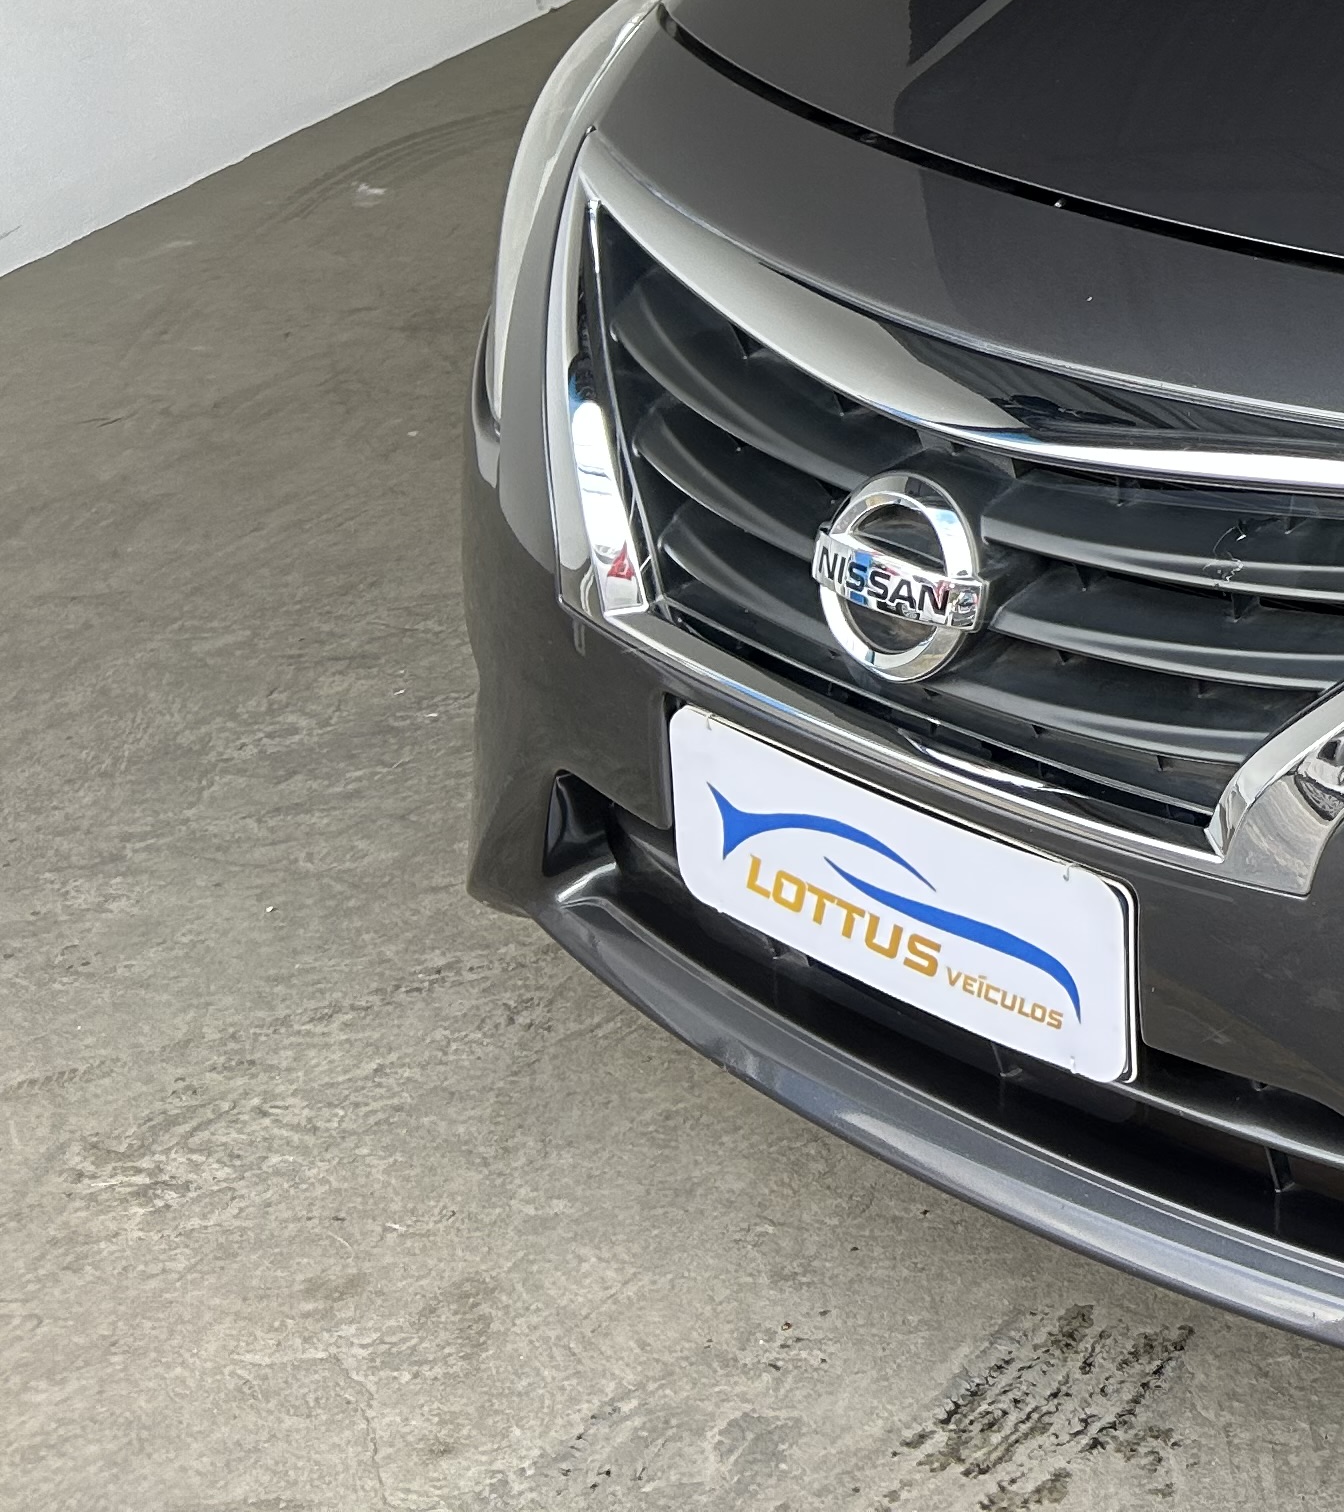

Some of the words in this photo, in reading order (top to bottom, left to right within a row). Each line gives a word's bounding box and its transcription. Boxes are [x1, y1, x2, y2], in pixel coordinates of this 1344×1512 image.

[817, 544, 950, 617] NISSAN
[745, 854, 942, 978] LOTTUS
[945, 965, 1064, 1031] VEÍCULOS
